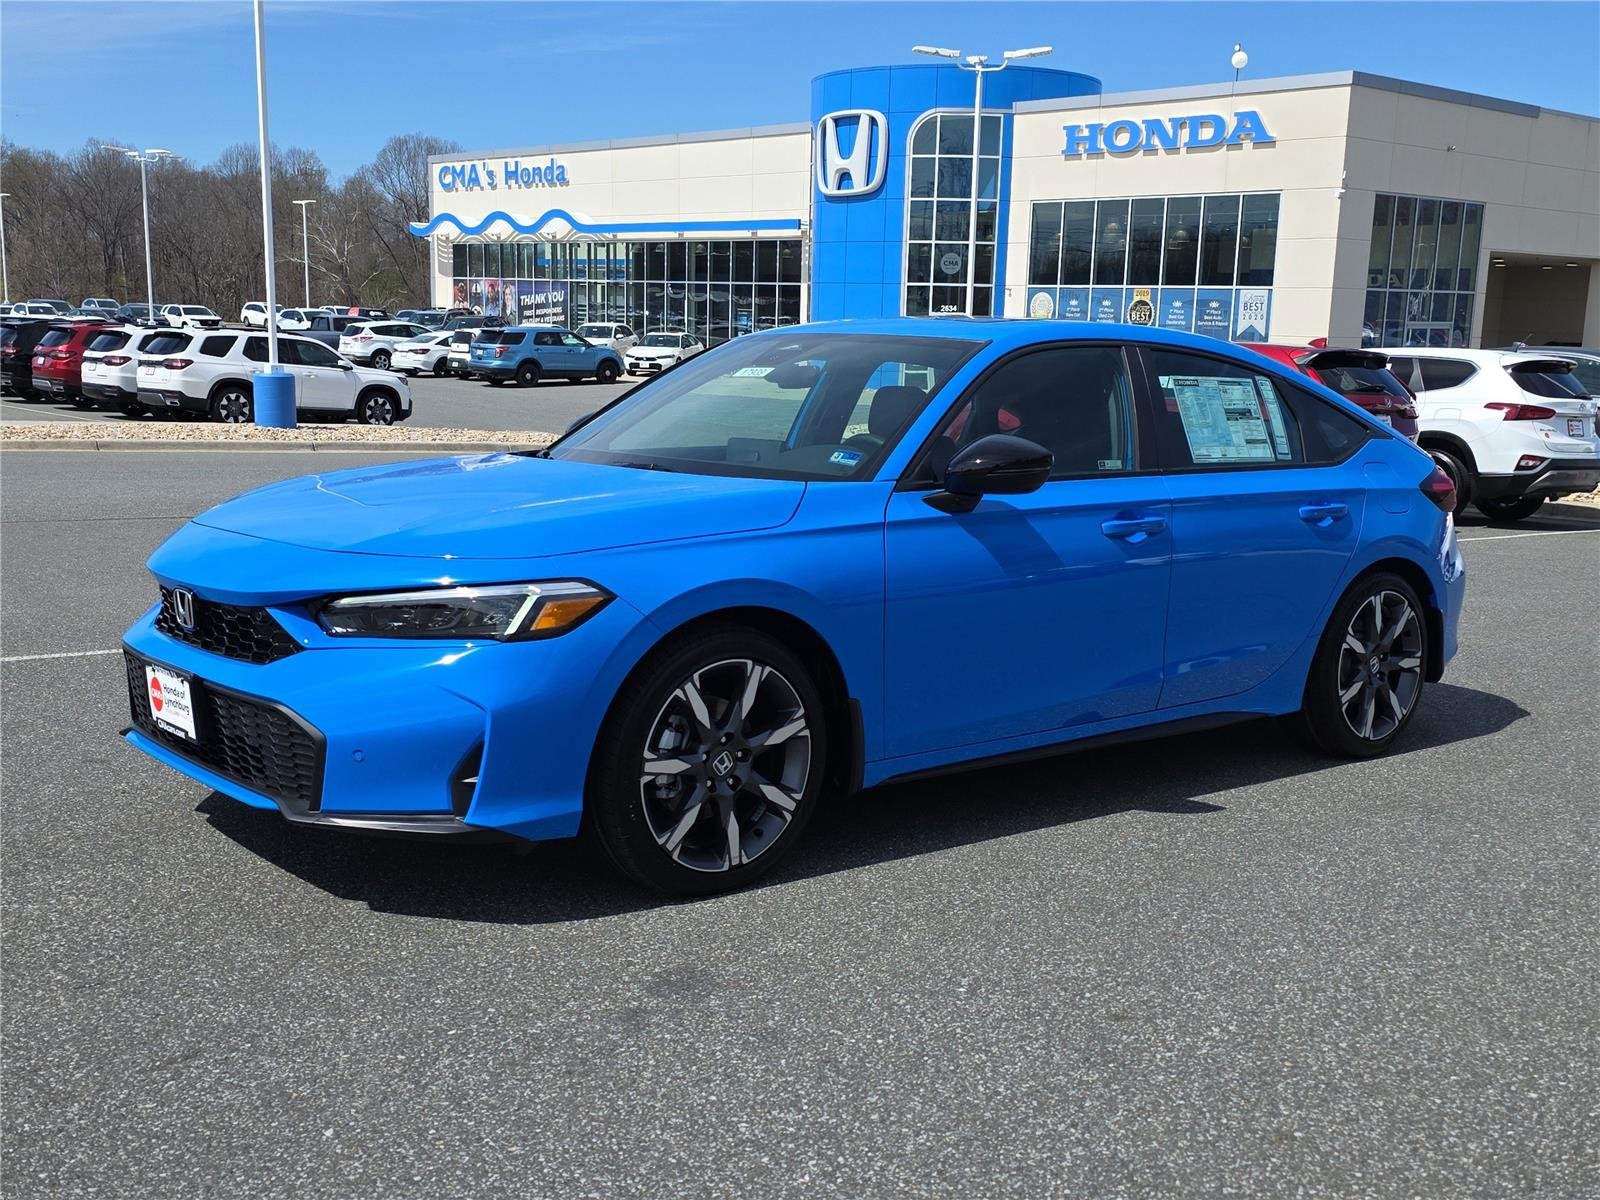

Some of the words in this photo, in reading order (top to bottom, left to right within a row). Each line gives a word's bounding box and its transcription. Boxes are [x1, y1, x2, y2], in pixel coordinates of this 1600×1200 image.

[1062, 110, 1276, 155] HONDA
[438, 162, 497, 191] CMA's
[505, 158, 567, 187] Honda
[520, 294, 546, 306] THANK
[548, 290, 564, 303] YOU
[1244, 302, 1264, 311] BEST
[1132, 312, 1149, 321] BEST
[165, 699, 189, 715] Lynchburg
